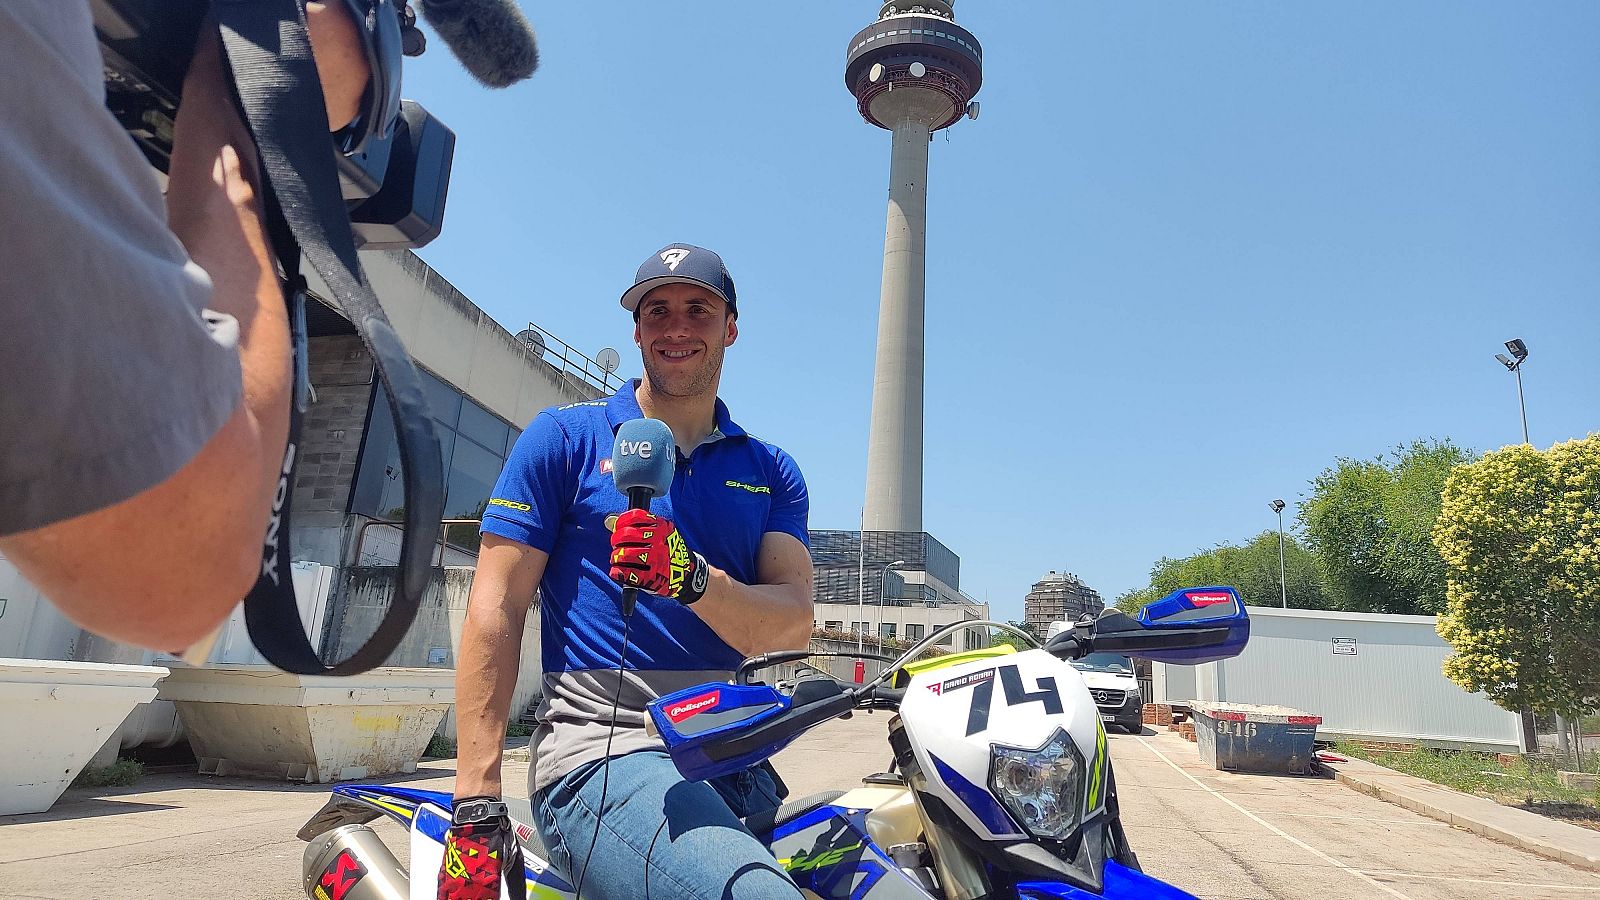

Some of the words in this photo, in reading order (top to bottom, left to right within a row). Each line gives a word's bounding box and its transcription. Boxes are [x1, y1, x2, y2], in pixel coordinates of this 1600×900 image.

[620, 440, 652, 459] tve
[670, 696, 716, 717] Polisport
[944, 664, 1064, 737] 74
